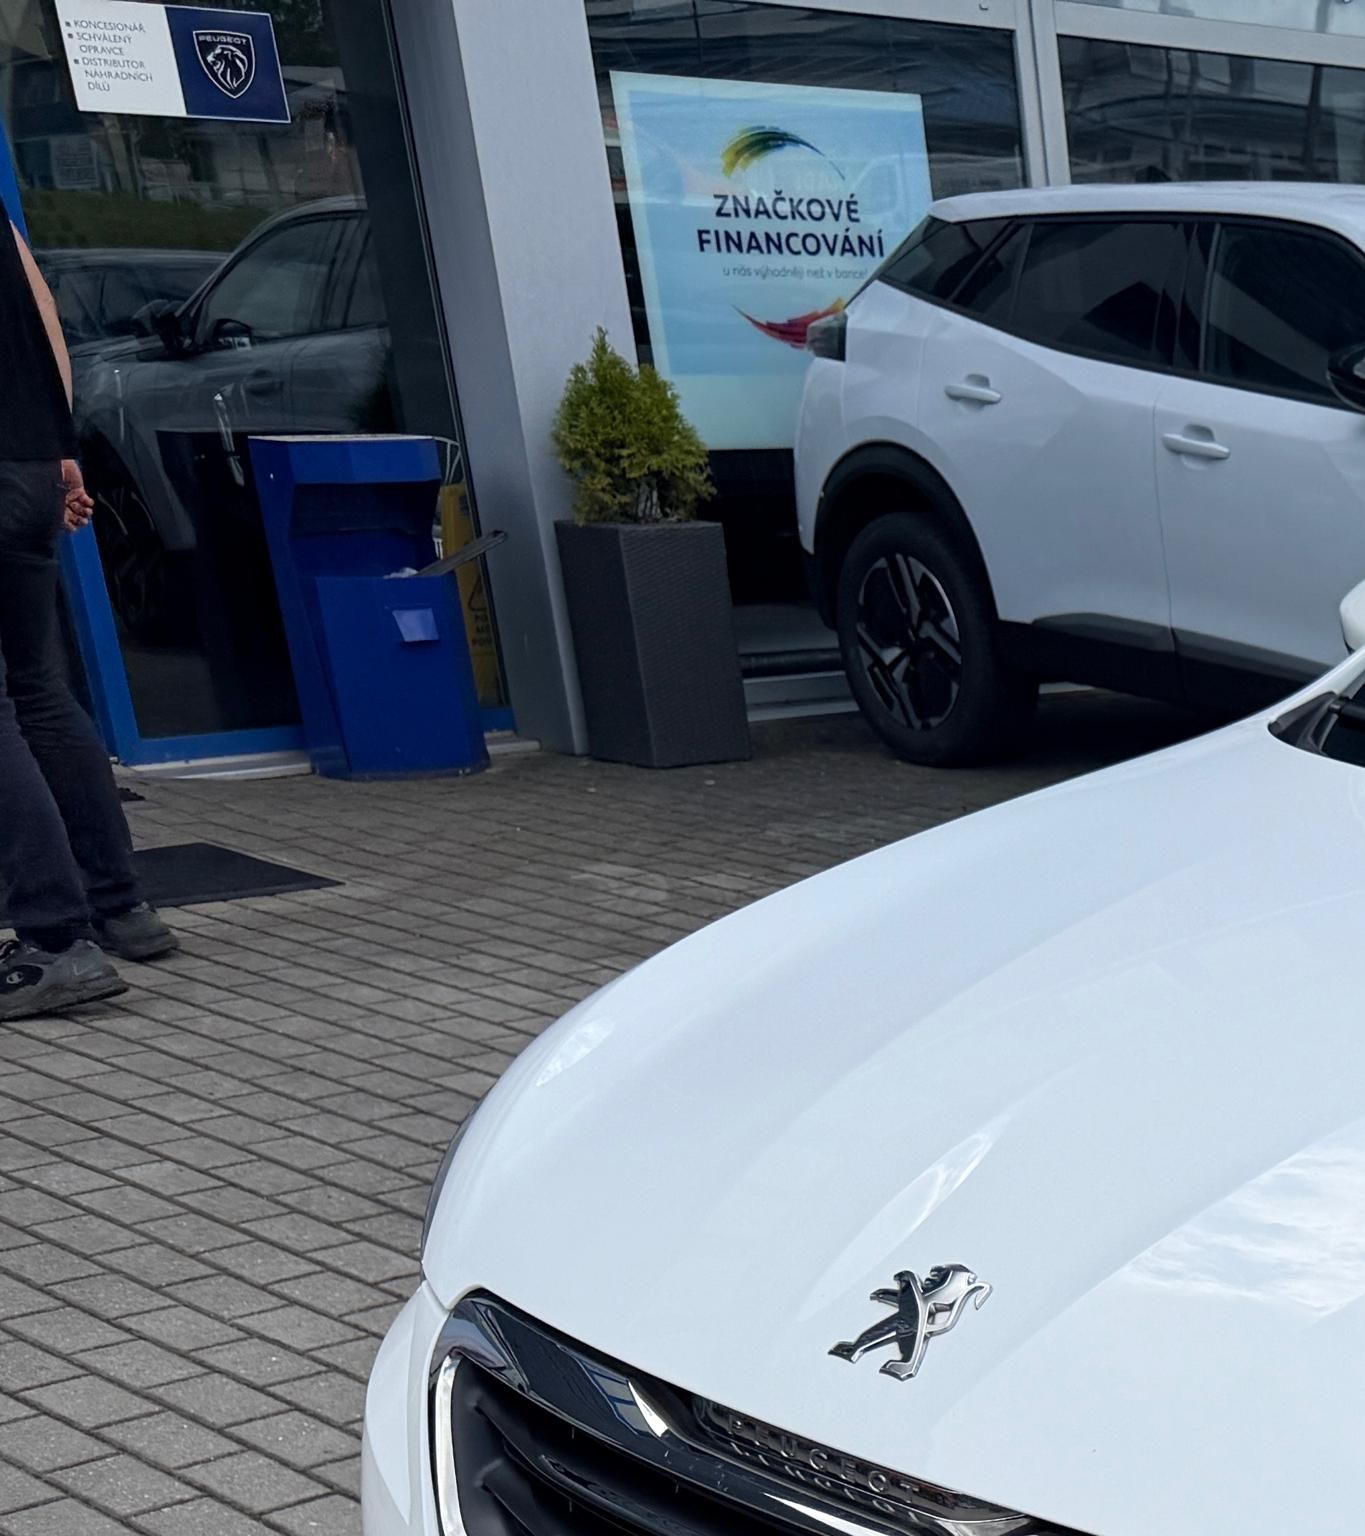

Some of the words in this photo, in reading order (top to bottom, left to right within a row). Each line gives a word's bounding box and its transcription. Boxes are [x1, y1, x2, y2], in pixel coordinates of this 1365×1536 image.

[79, 44, 124, 56] OPRAVCE
[198, 34, 248, 45] PEUGEOT
[81, 57, 146, 69] DISTRIBUTOR
[713, 189, 860, 223] ZNAČKOVÉ
[697, 228, 885, 258] FINANCOVÁNÍ
[728, 1414, 920, 1504] PEUGEOT
